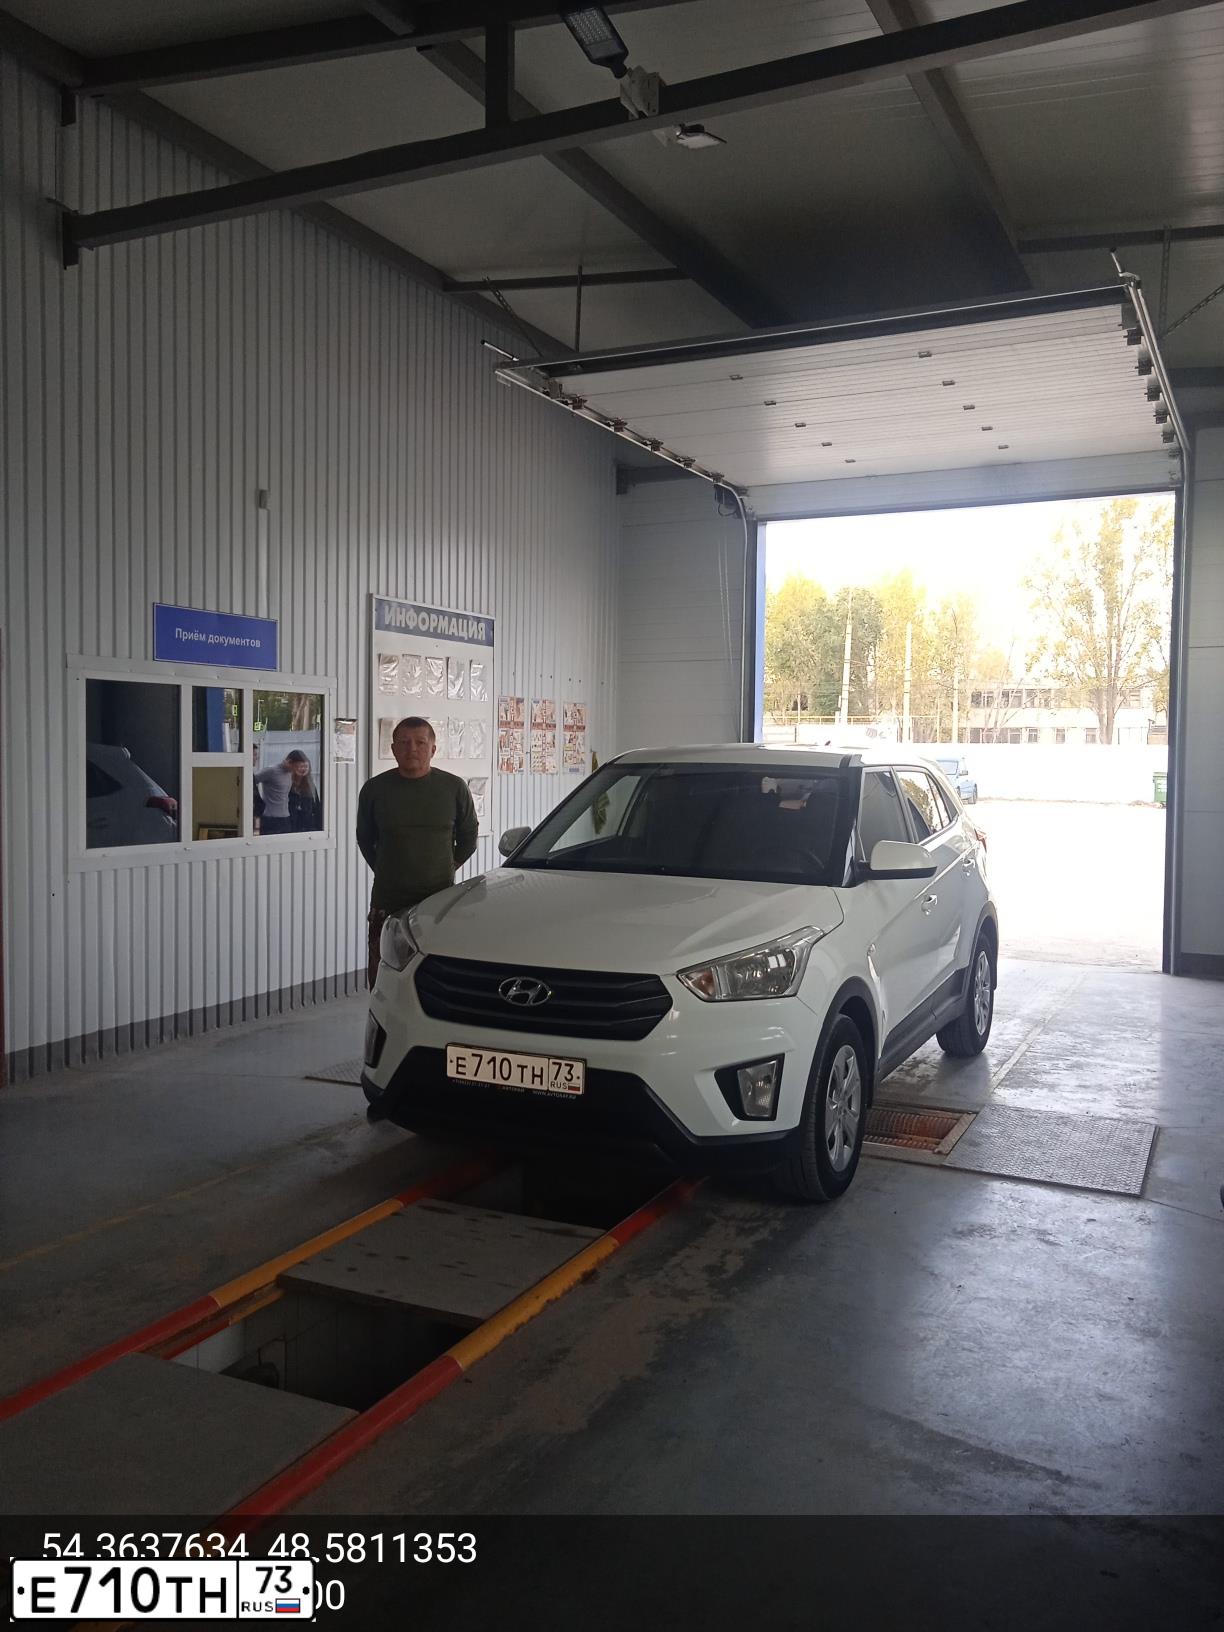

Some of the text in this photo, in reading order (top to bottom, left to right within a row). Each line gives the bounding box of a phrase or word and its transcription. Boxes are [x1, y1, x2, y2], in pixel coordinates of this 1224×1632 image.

[384, 604, 486, 641] ИНФОРМАЦИЯ
[175, 627, 261, 648] Приём документов
[552, 1062, 575, 1082] 73
[550, 1081, 567, 1090] RUS
